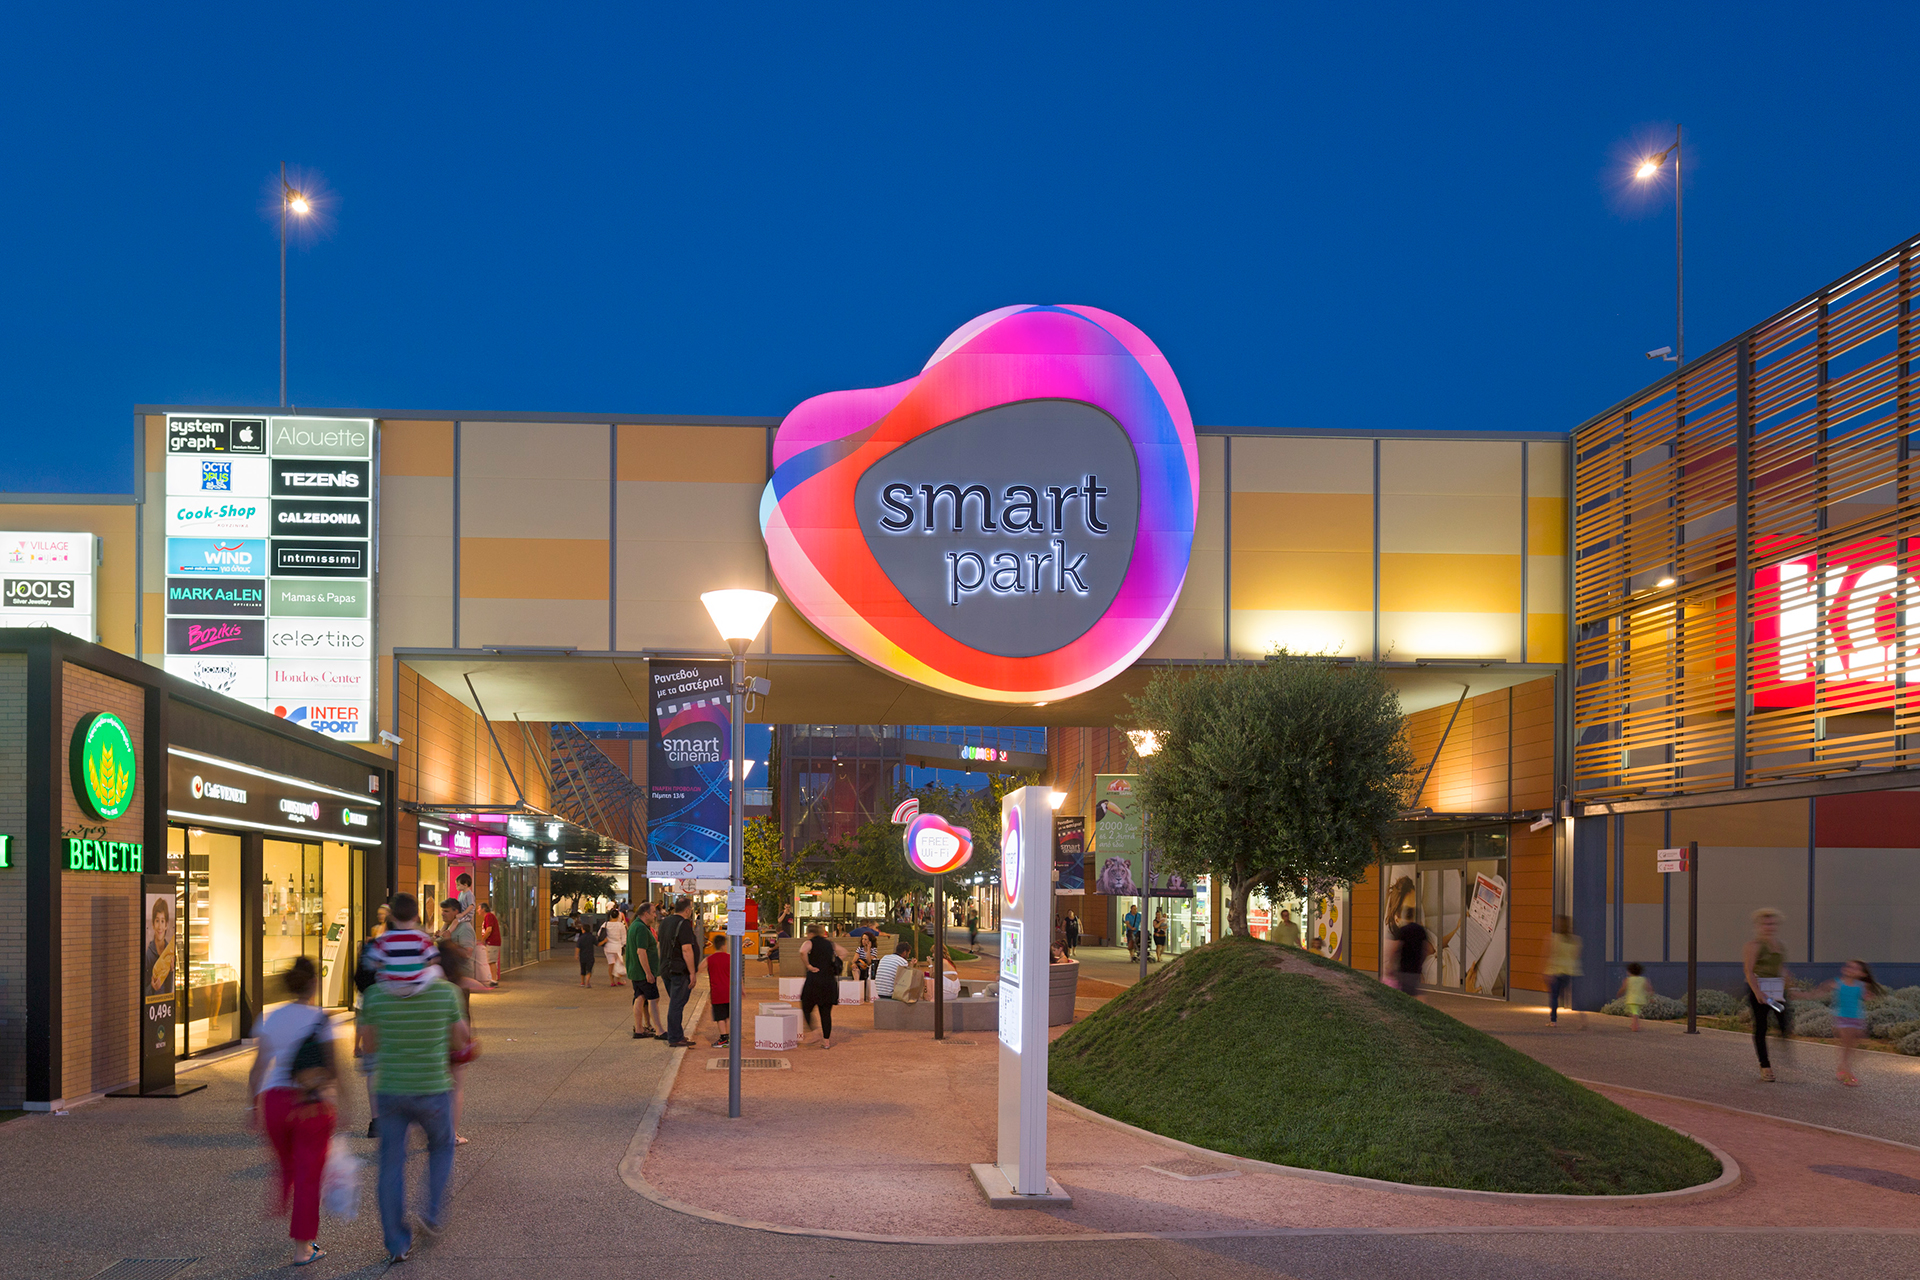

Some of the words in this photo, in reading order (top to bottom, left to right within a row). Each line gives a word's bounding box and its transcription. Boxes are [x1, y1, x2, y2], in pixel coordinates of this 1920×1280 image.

[170, 419, 224, 436] system
[276, 427, 365, 447] Alouette
[281, 470, 360, 488] TEZENIS
[879, 473, 1109, 533] smart
[177, 504, 256, 520] Cook-Shop
[278, 512, 361, 525] CALZEDONIA
[30, 541, 69, 551] VILLAGE
[204, 551, 253, 565] WIND
[283, 552, 356, 565] intimissimi
[946, 539, 1090, 606] park
[6, 581, 72, 599] JOOLS
[170, 588, 213, 601] MARK
[281, 592, 316, 603] Mamas
[317, 593, 326, 603] &
[327, 593, 356, 605] Papas
[188, 623, 242, 647] Bozikis
[272, 630, 365, 648] celestino
[274, 670, 319, 683] Hondos
[321, 671, 361, 684] Center
[654, 667, 699, 684] Ραντεβού
[657, 689, 667, 699] με
[678, 675, 724, 691] αστέρια!
[311, 706, 359, 720] INTER
[310, 720, 359, 733] SPORT
[663, 737, 719, 752] smart
[668, 750, 720, 762] cinema
[1100, 821, 1123, 831] 2000
[921, 836, 949, 846] FREE
[1108, 830, 1114, 839] 2
[921, 848, 949, 858] Wi-Fi
[149, 1003, 172, 1022] 0,49€
[755, 1039, 783, 1049] chillbox
